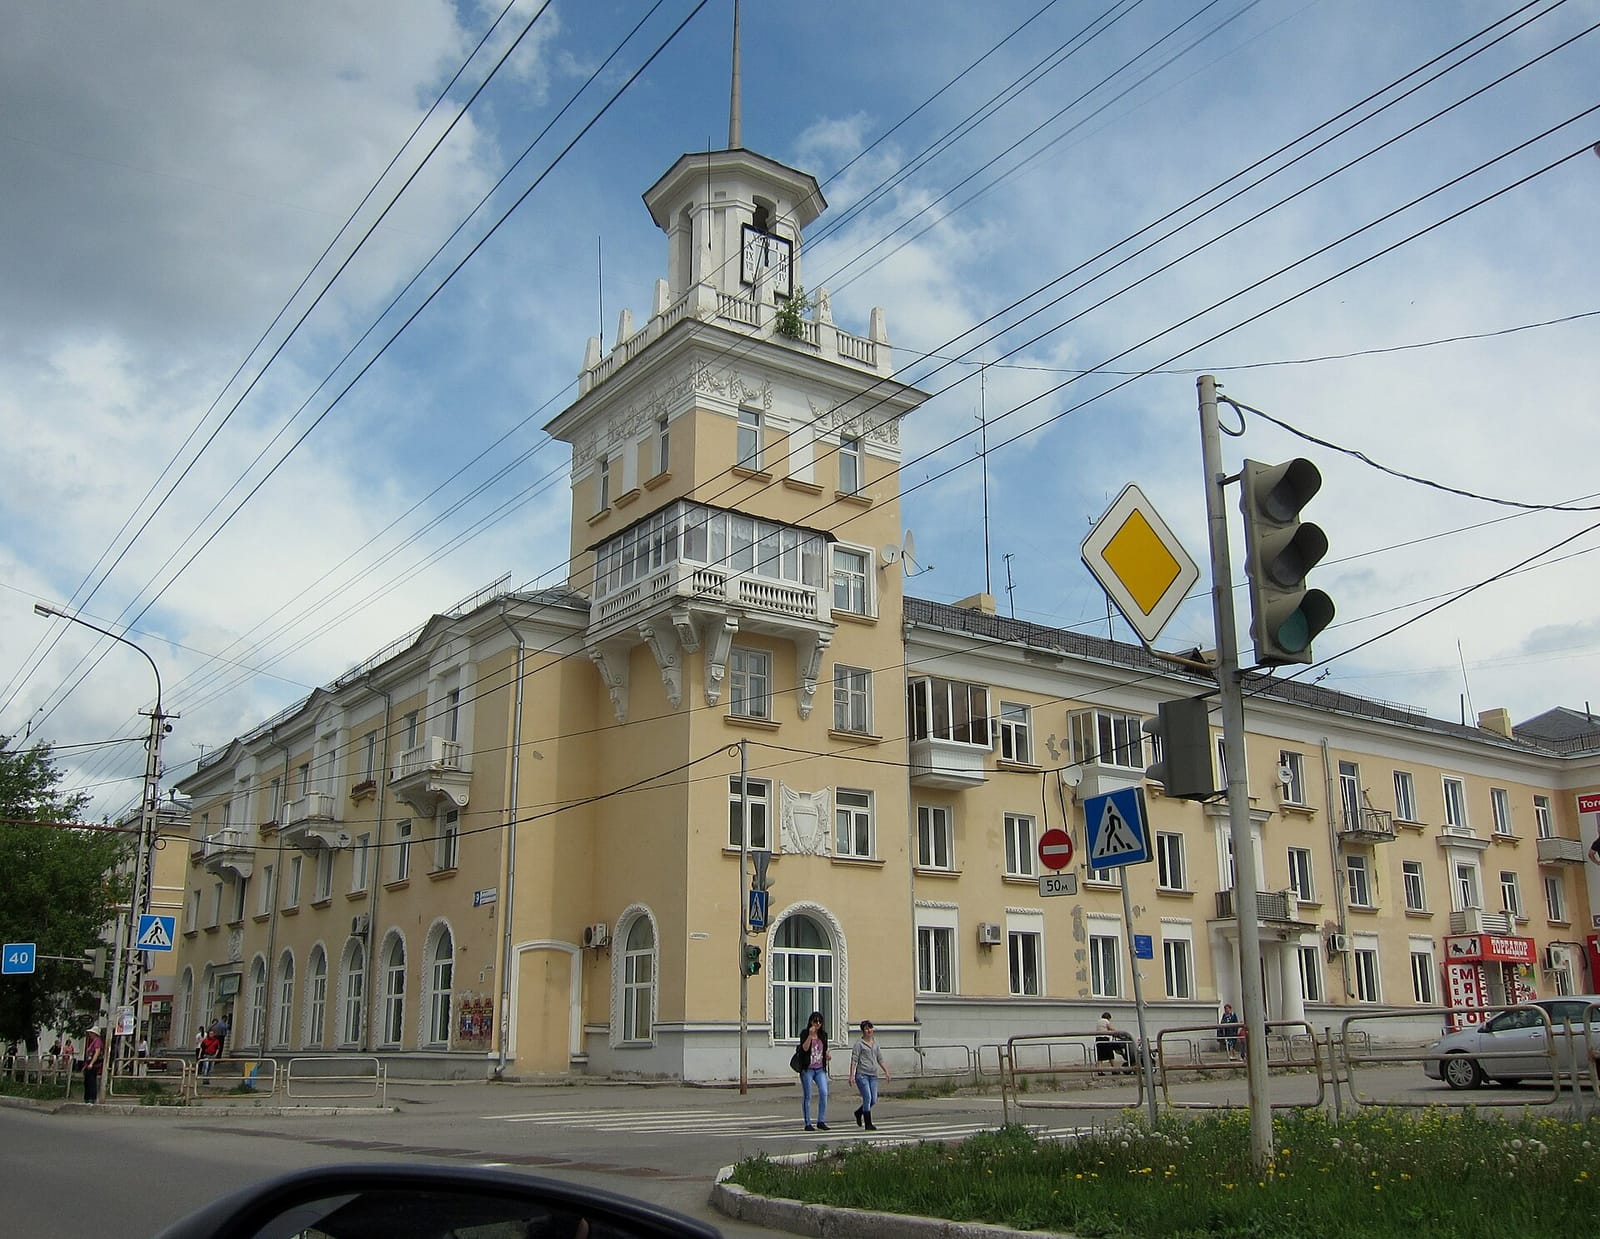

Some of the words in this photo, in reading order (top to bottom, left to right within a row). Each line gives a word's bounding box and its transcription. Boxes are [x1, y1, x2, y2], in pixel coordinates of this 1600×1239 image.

[1490, 938, 1528, 957] ТОРЕАДОР
[9, 952, 28, 964] 40
[1459, 968, 1477, 1024] МЯСО
